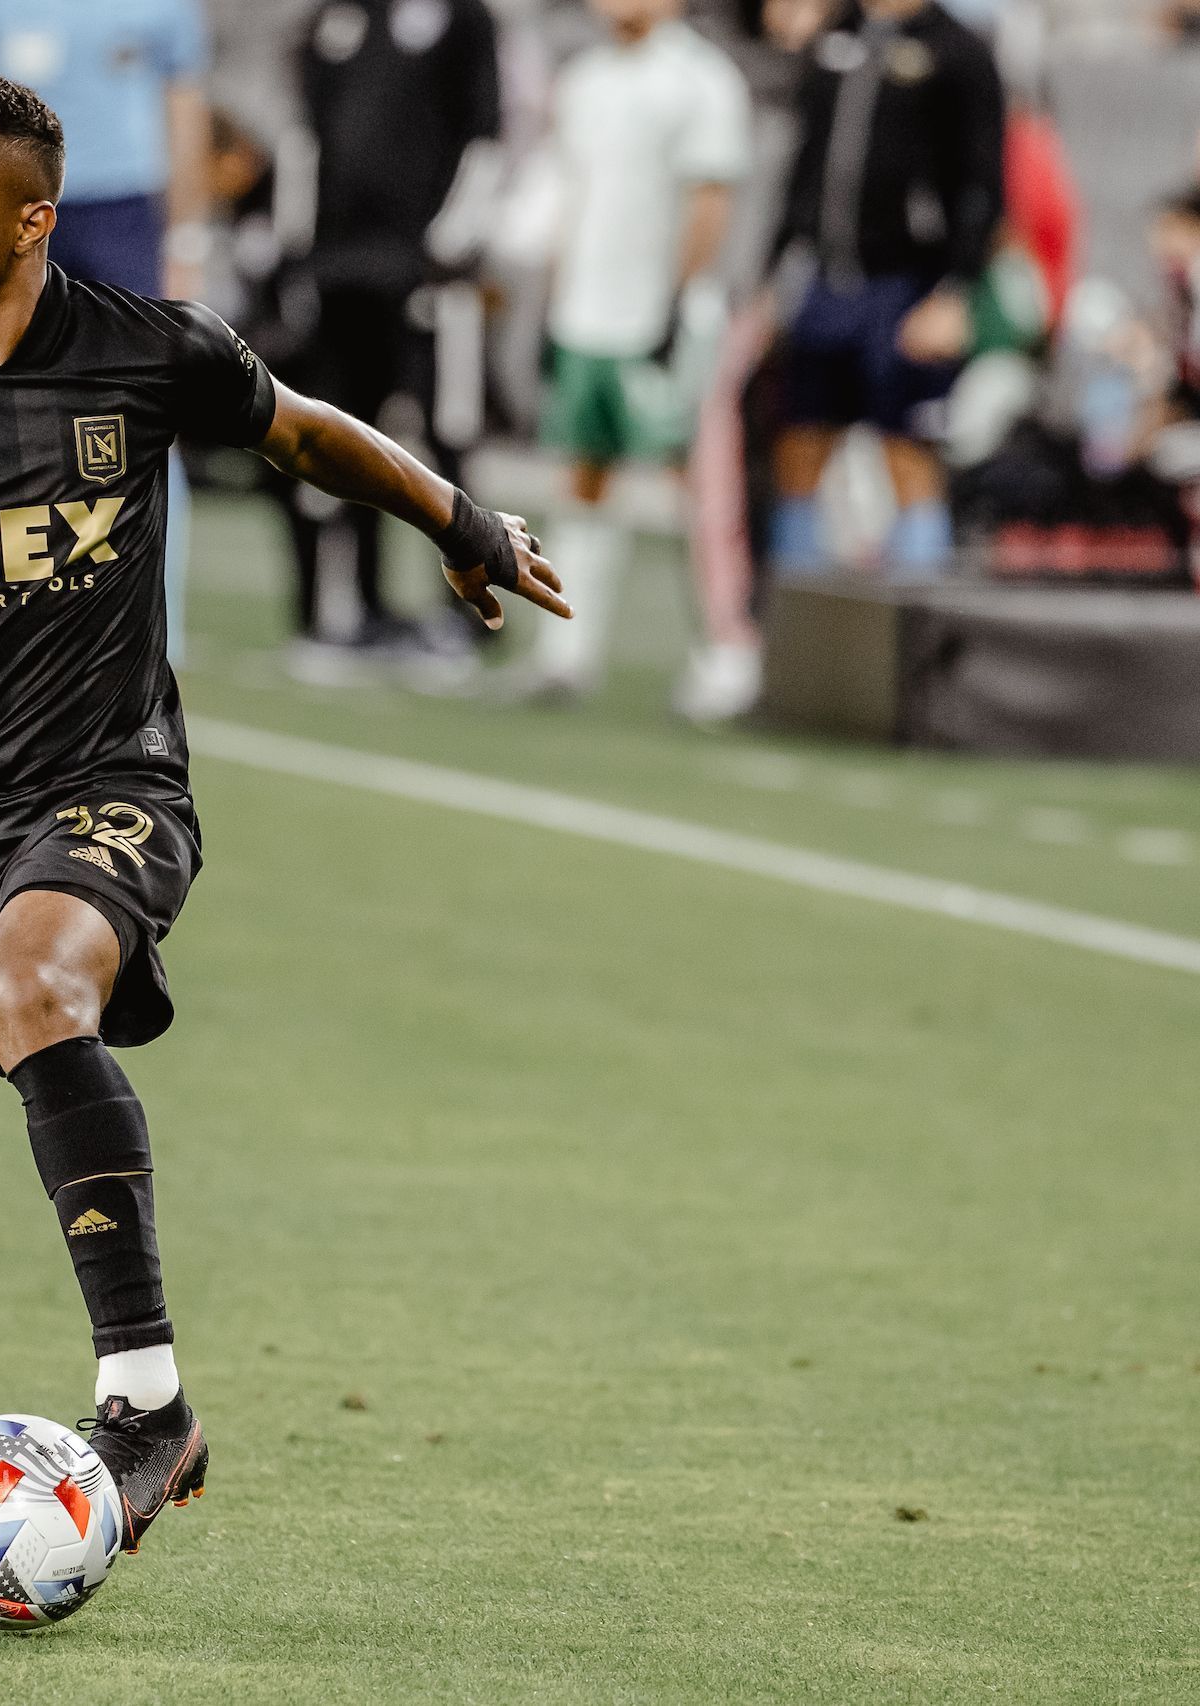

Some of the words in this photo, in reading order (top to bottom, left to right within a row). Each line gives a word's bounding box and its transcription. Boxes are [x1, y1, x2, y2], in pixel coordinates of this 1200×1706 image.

[20, 574, 95, 606] TOLS
[68, 848, 119, 877] adidas
[67, 1221, 118, 1236] adidas
